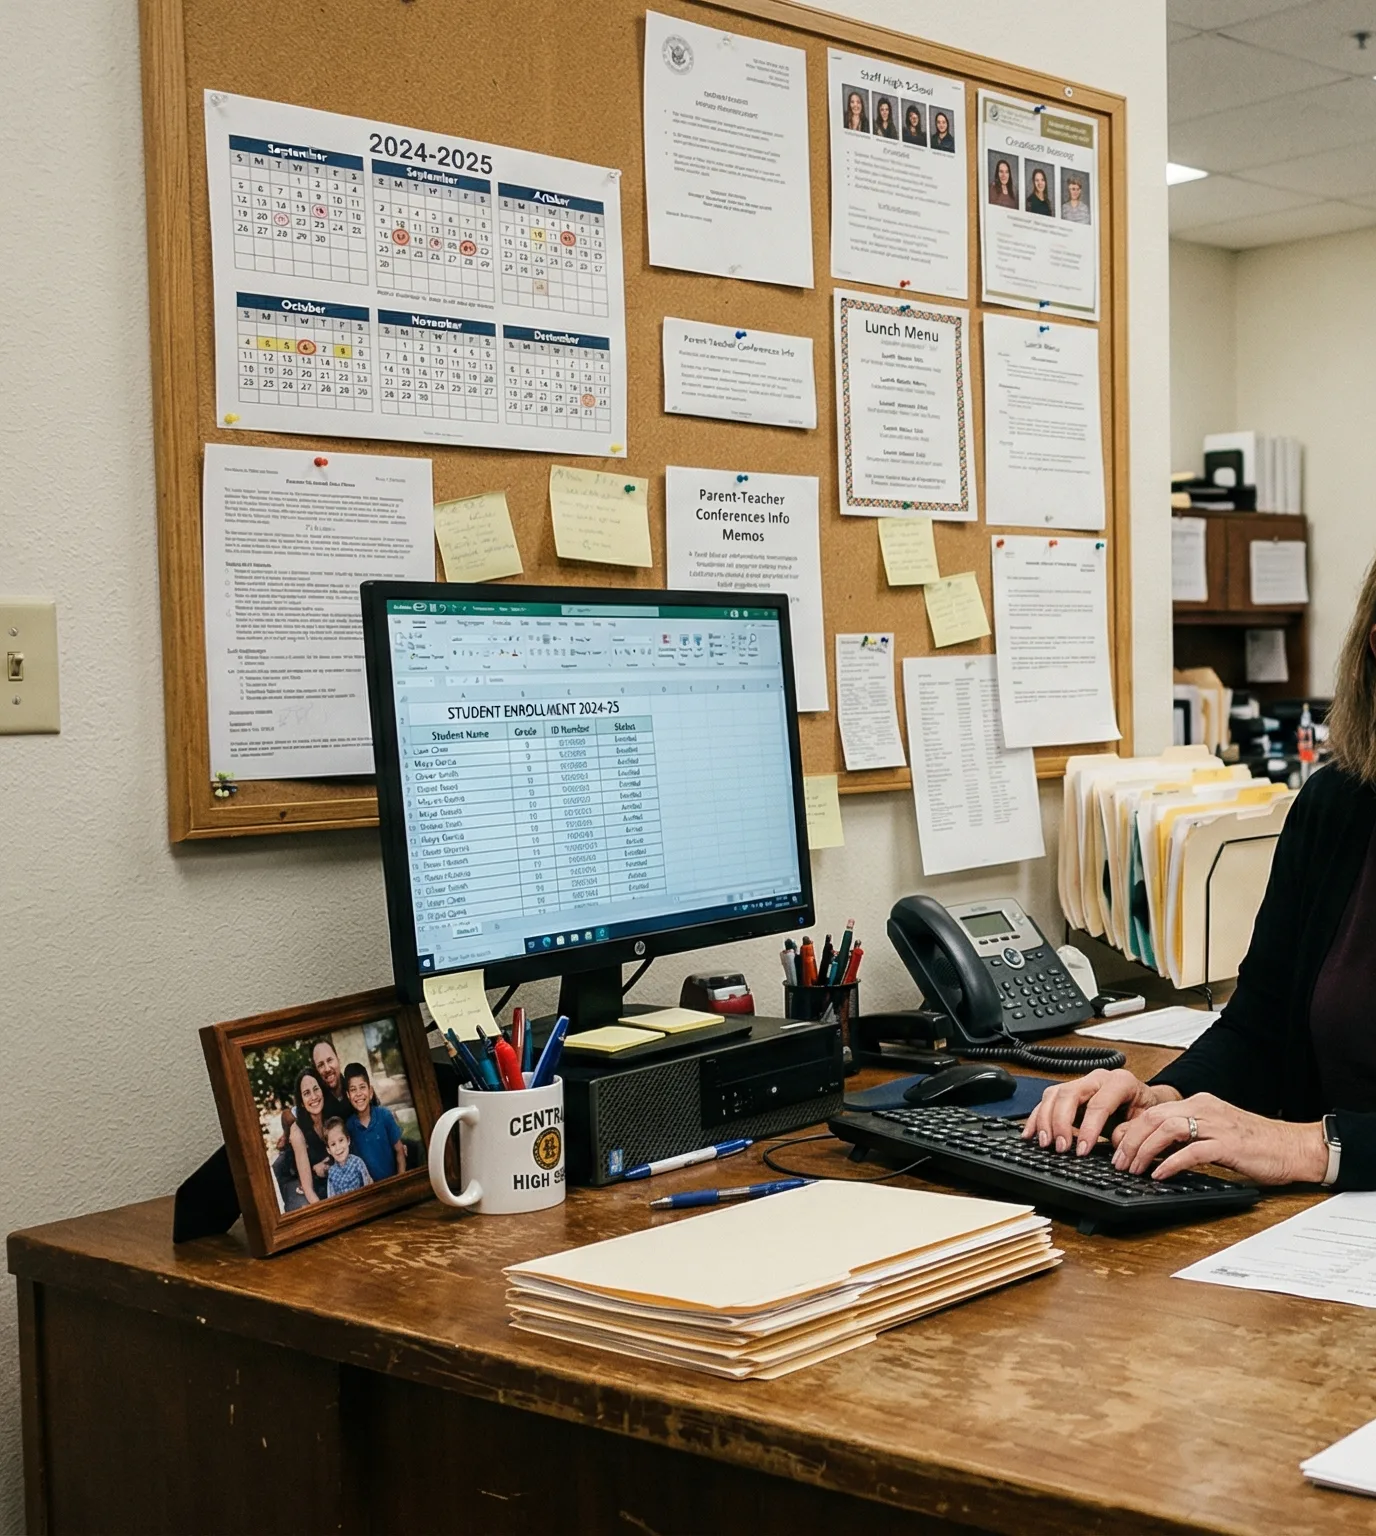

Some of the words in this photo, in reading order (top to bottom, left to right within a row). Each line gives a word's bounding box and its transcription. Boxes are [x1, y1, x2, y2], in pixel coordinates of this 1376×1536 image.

[369, 133, 492, 174] 2024-2025
[254, 157, 264, 165] M
[333, 196, 342, 204] 10
[238, 224, 248, 232] 26
[866, 320, 900, 337] Lunch
[905, 326, 938, 342] Menu
[263, 353, 273, 361] 12
[700, 489, 785, 505] Parent-Teacher
[696, 508, 765, 523] Conferences
[769, 512, 789, 524] Info
[723, 529, 764, 541] Memos
[448, 706, 501, 719] STUDENT
[432, 731, 464, 740] Student
[551, 726, 559, 735] ID
[513, 1172, 550, 1190] HIGH
